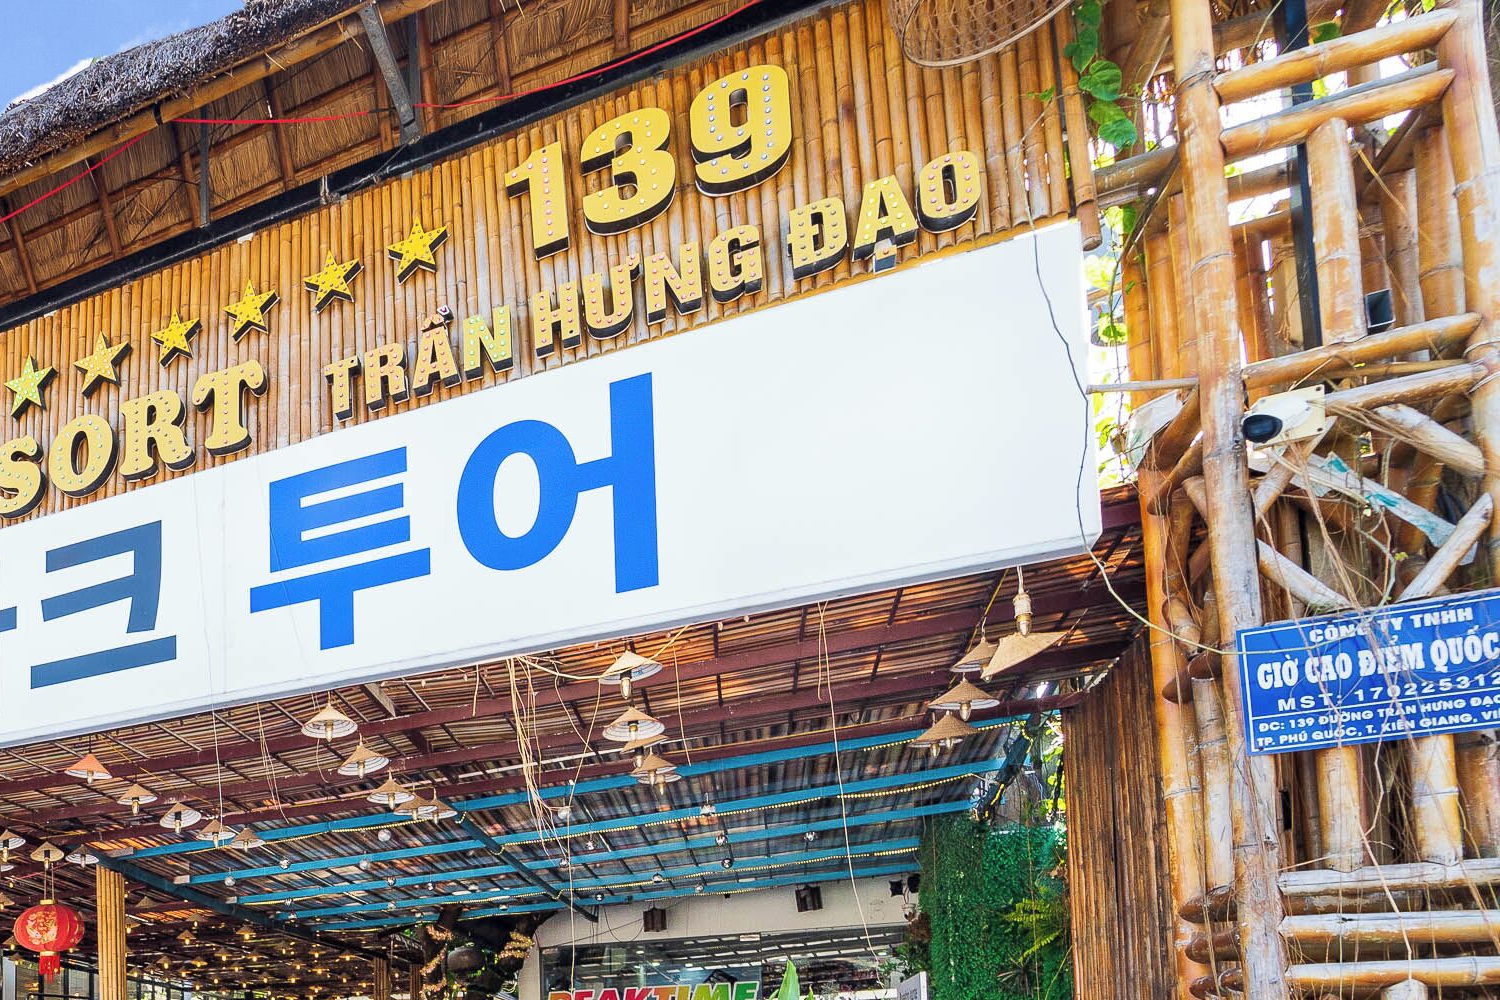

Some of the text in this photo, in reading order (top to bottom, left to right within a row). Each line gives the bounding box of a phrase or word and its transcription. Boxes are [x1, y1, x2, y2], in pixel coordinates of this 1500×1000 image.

[505, 64, 792, 260] 139
[323, 150, 982, 421] TRẦN HƯNG ĐẠO
[250, 372, 659, 650] 투어
[1377, 617, 1403, 632] TY
[1410, 607, 1473, 629] TNHH
[1257, 654, 1299, 689] GIỜ
[1304, 652, 1353, 683] CAO
[1430, 625, 1500, 673] QUỐC
[1278, 693, 1343, 712] MST:
[1289, 717, 1314, 728] 139
[1420, 698, 1466, 713] HƯNG
[1257, 735, 1276, 747] TP.
[1279, 730, 1308, 744] PHÚ
[1419, 713, 1478, 728] GIANG,
